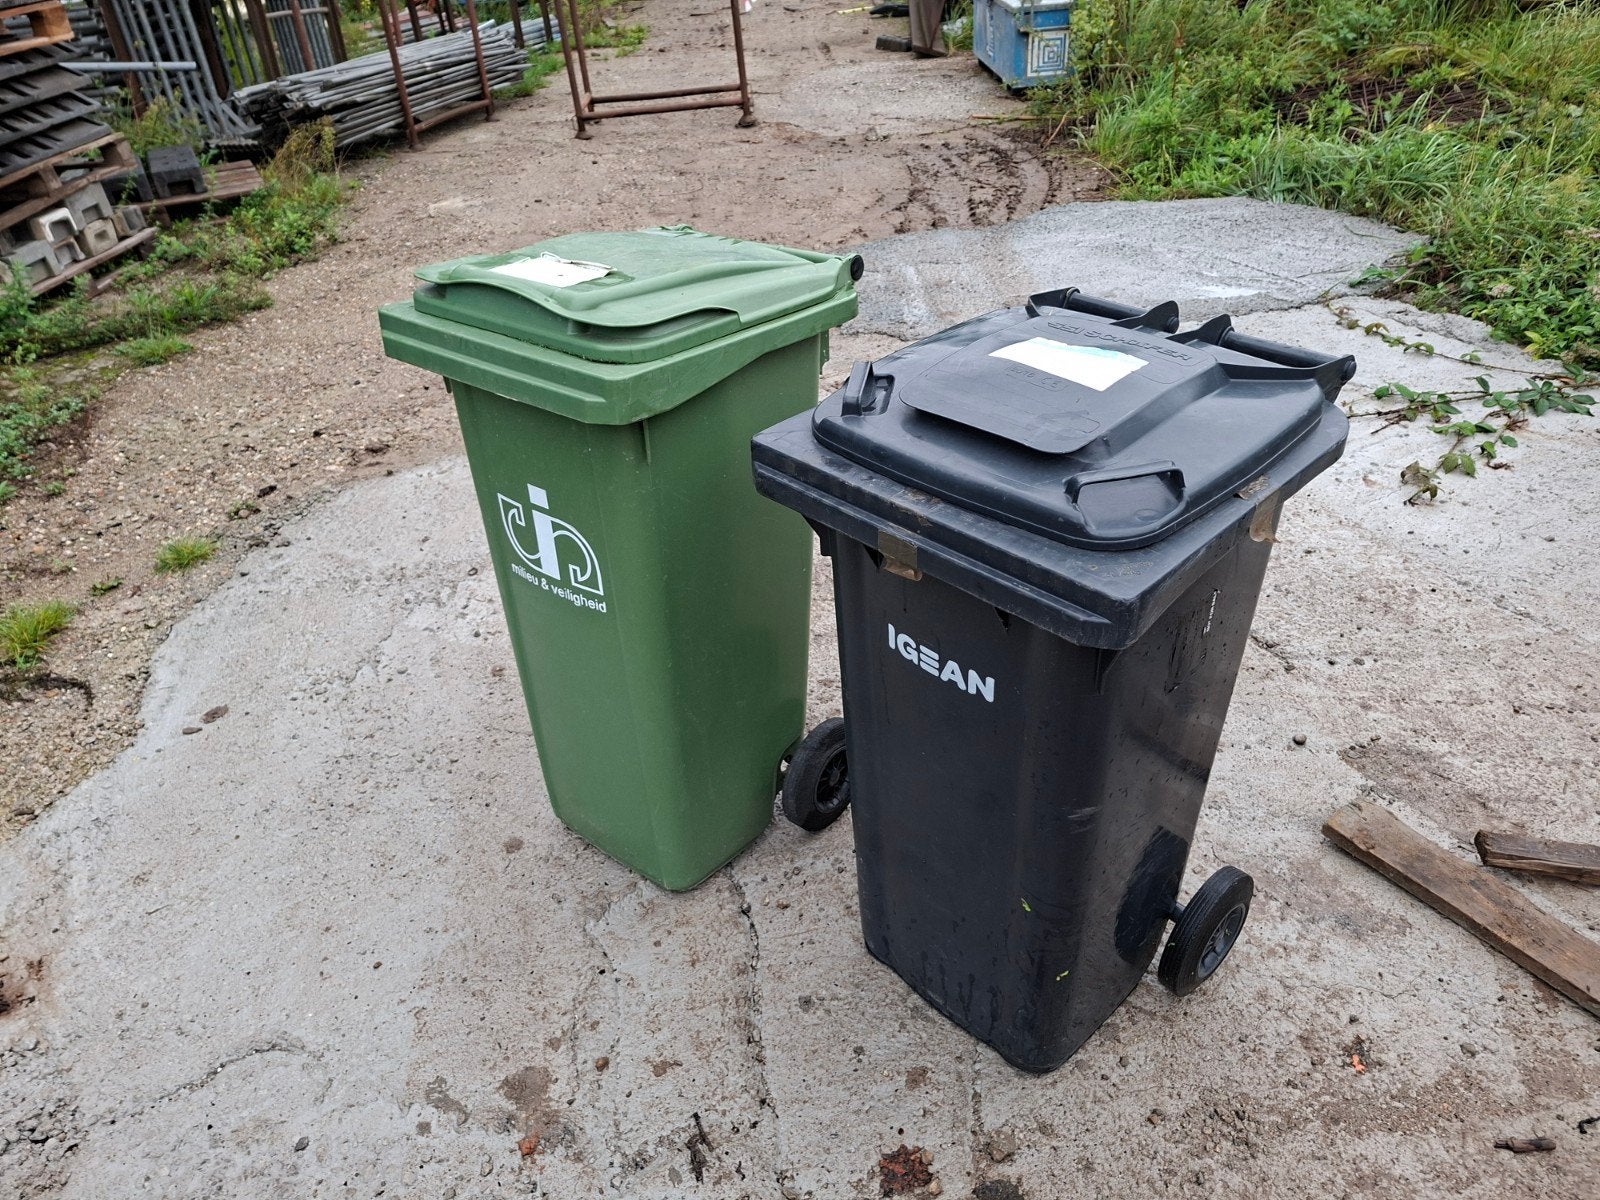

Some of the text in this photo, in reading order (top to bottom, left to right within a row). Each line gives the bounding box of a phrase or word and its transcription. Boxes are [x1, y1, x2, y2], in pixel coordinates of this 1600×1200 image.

[511, 563, 607, 613] milieu & veiligheid
[888, 623, 995, 703] IGEAN
